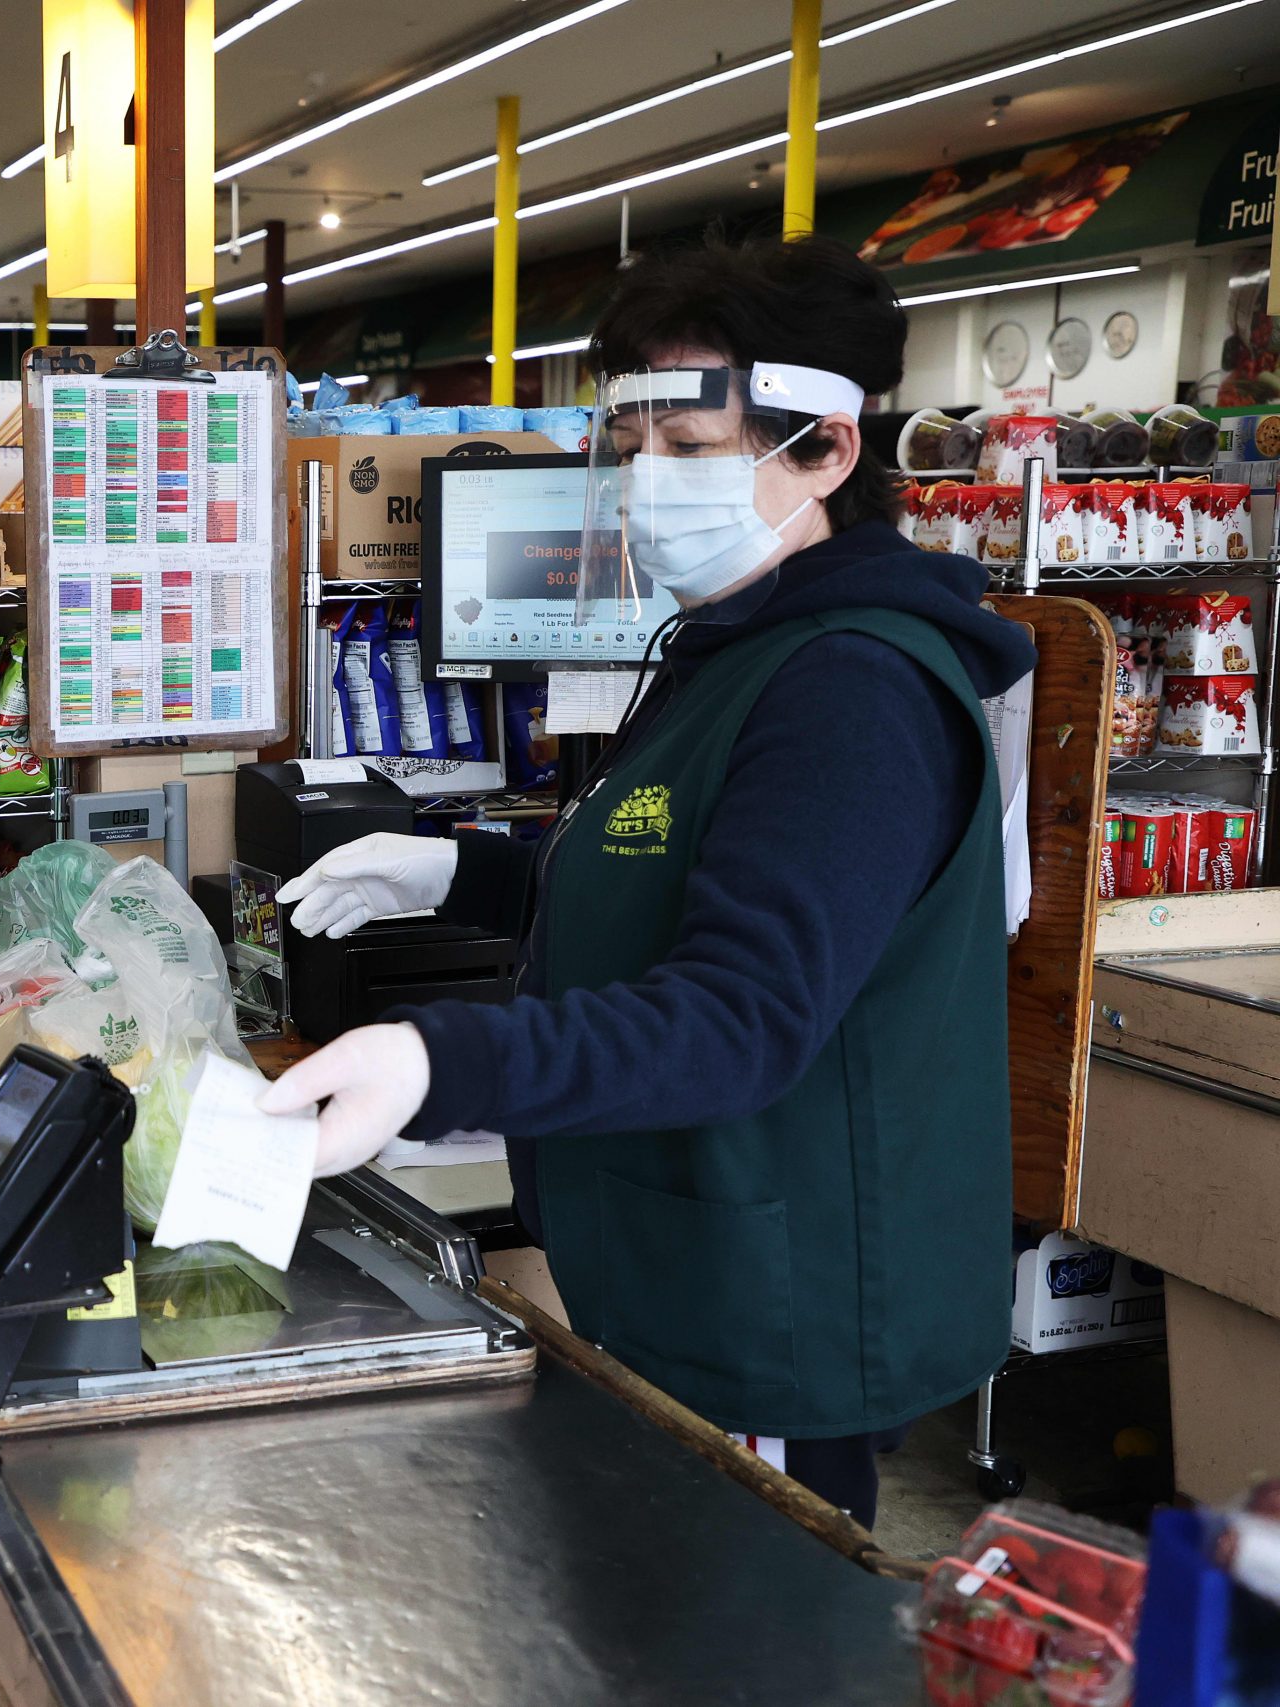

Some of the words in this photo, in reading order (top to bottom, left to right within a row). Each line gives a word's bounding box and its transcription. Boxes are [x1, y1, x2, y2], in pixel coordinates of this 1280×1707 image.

[54, 51, 75, 183] 4
[1228, 193, 1276, 230] Frui
[354, 472, 375, 480] NON
[459, 474, 481, 485] 0.03
[354, 480, 376, 488] GMO
[349, 543, 390, 557] GLUTEN
[393, 542, 420, 556] FREE
[523, 545, 581, 561] Change
[112, 810, 140, 825] 0.03
[609, 819, 644, 832] PAT'S
[602, 845, 617, 854] THE
[618, 846, 639, 856] BEST
[647, 845, 666, 854] LESS
[1101, 845, 1116, 899] Digestive
[1219, 841, 1235, 893] Digestive
[263, 928, 279, 945] PLACE
[1055, 1250, 1110, 1288] Sophia
[1039, 1330, 1046, 1338] 15
[1050, 1327, 1063, 1336] 8.82
